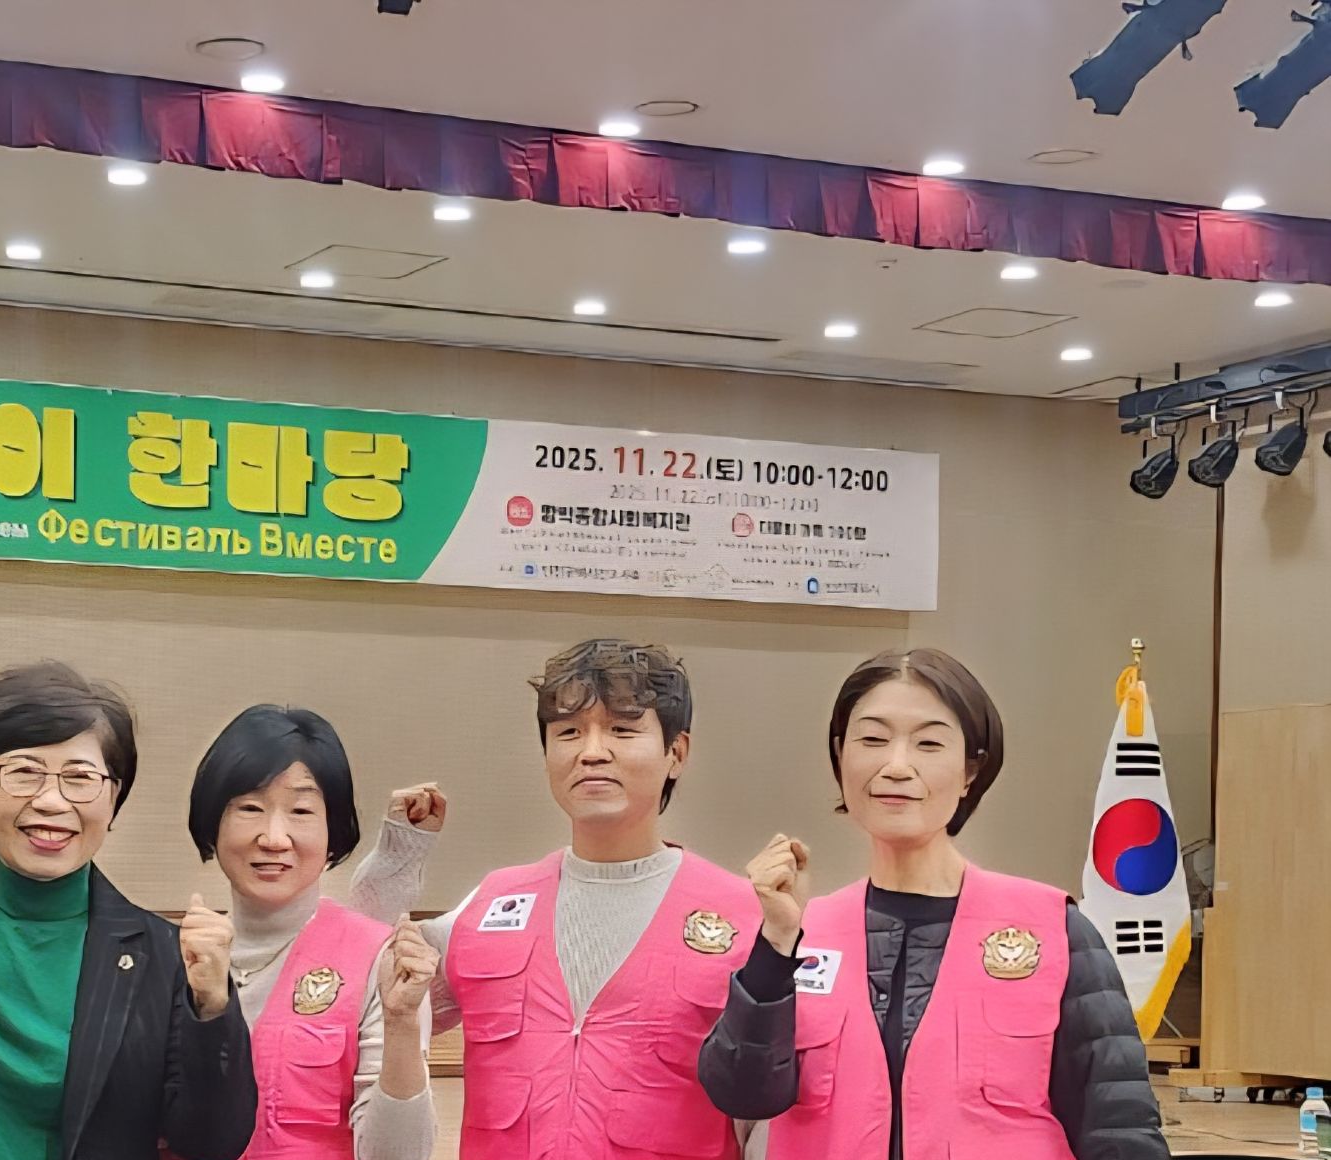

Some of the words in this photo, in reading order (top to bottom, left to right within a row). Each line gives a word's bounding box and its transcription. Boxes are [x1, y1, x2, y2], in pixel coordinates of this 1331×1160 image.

[127, 411, 410, 521] 한마당
[37, 508, 250, 555] Фестиваль
[259, 522, 398, 563] Вместе
